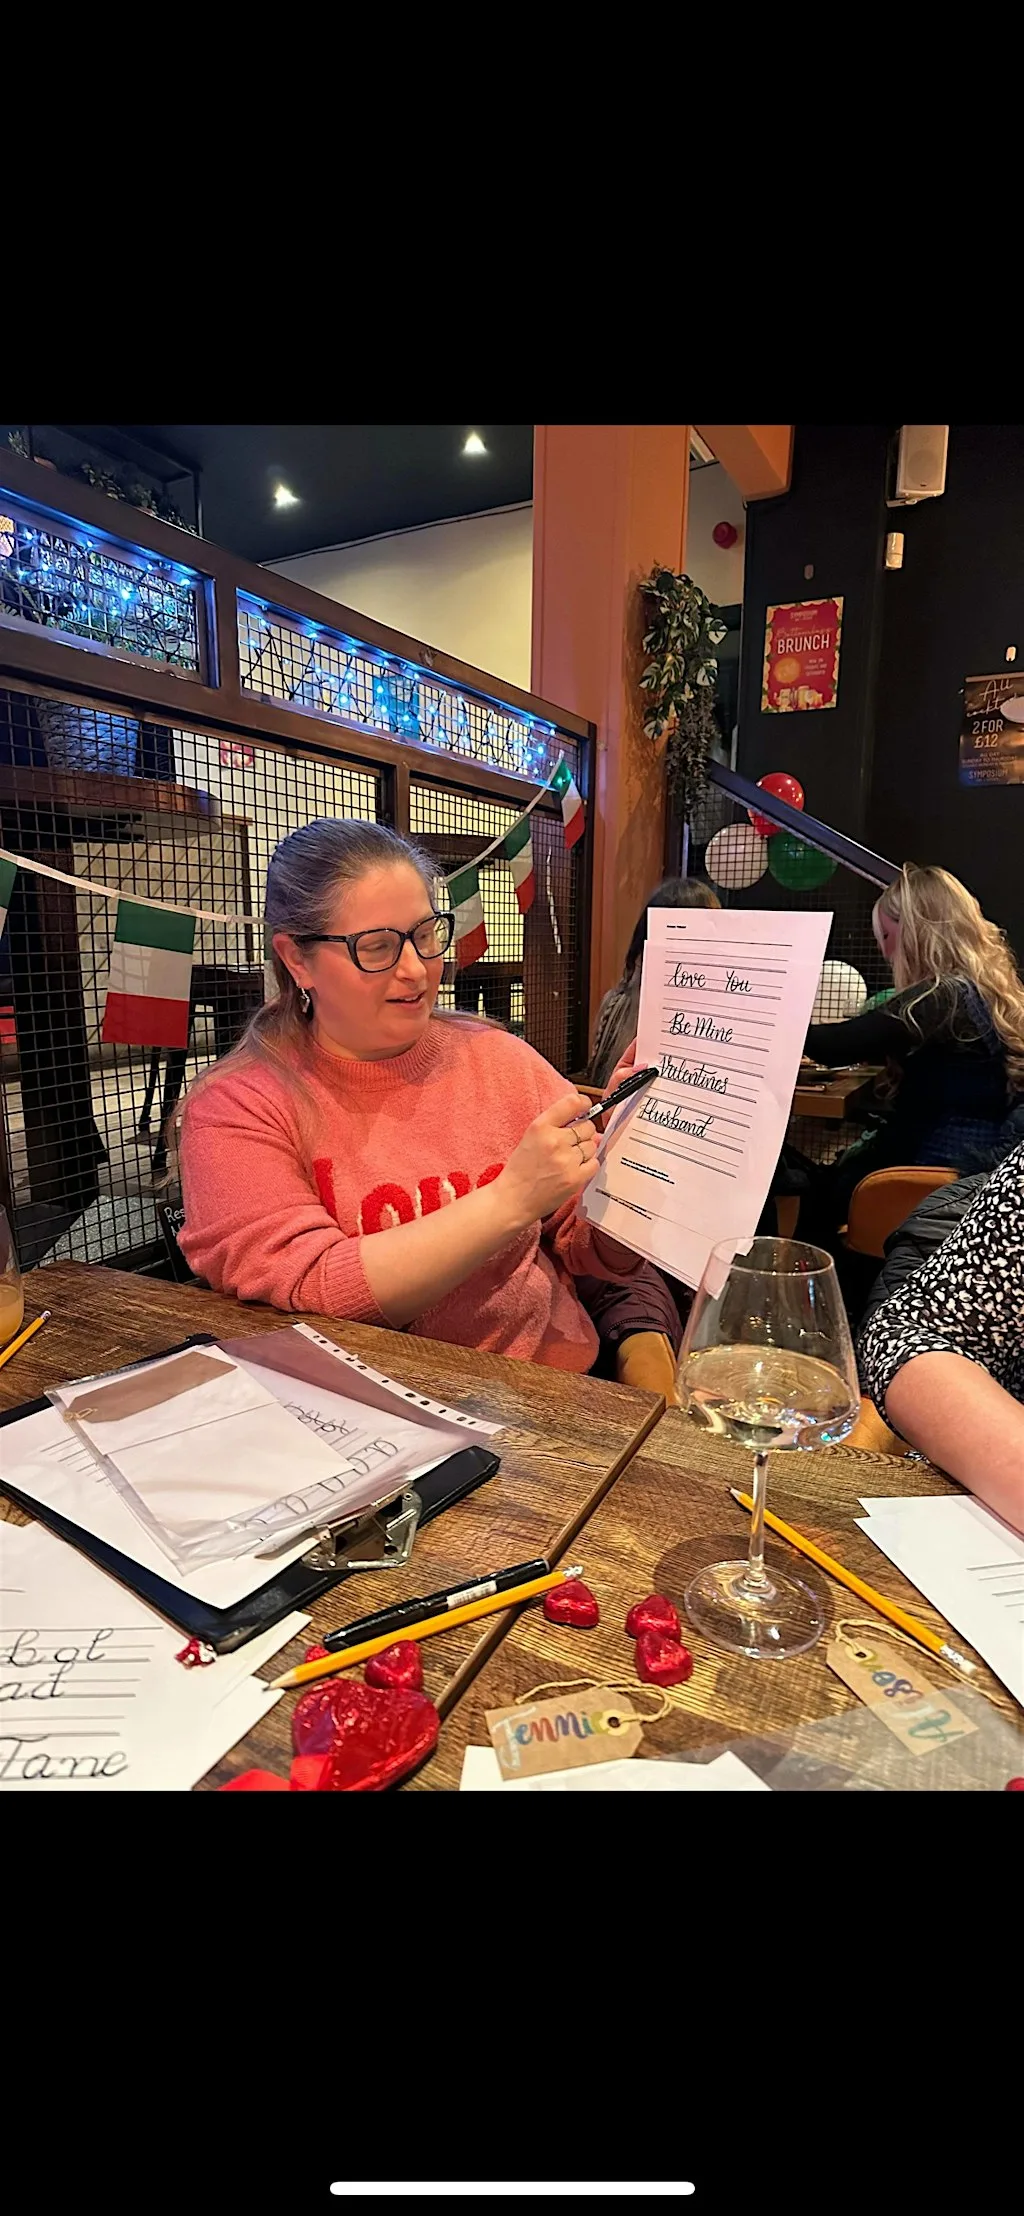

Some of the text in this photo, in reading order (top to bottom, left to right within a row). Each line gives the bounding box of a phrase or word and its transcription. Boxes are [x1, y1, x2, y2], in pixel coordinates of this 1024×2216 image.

[777, 633, 830, 655] BRUNCH
[979, 679, 1014, 701] All
[973, 733, 998, 749] £12
[968, 769, 1009, 780] SYMPOSIUM
[726, 970, 752, 993] You
[670, 1012, 733, 1043] Be Mine
[660, 1055, 729, 1095] Valentines
[640, 1098, 714, 1138] Husband
